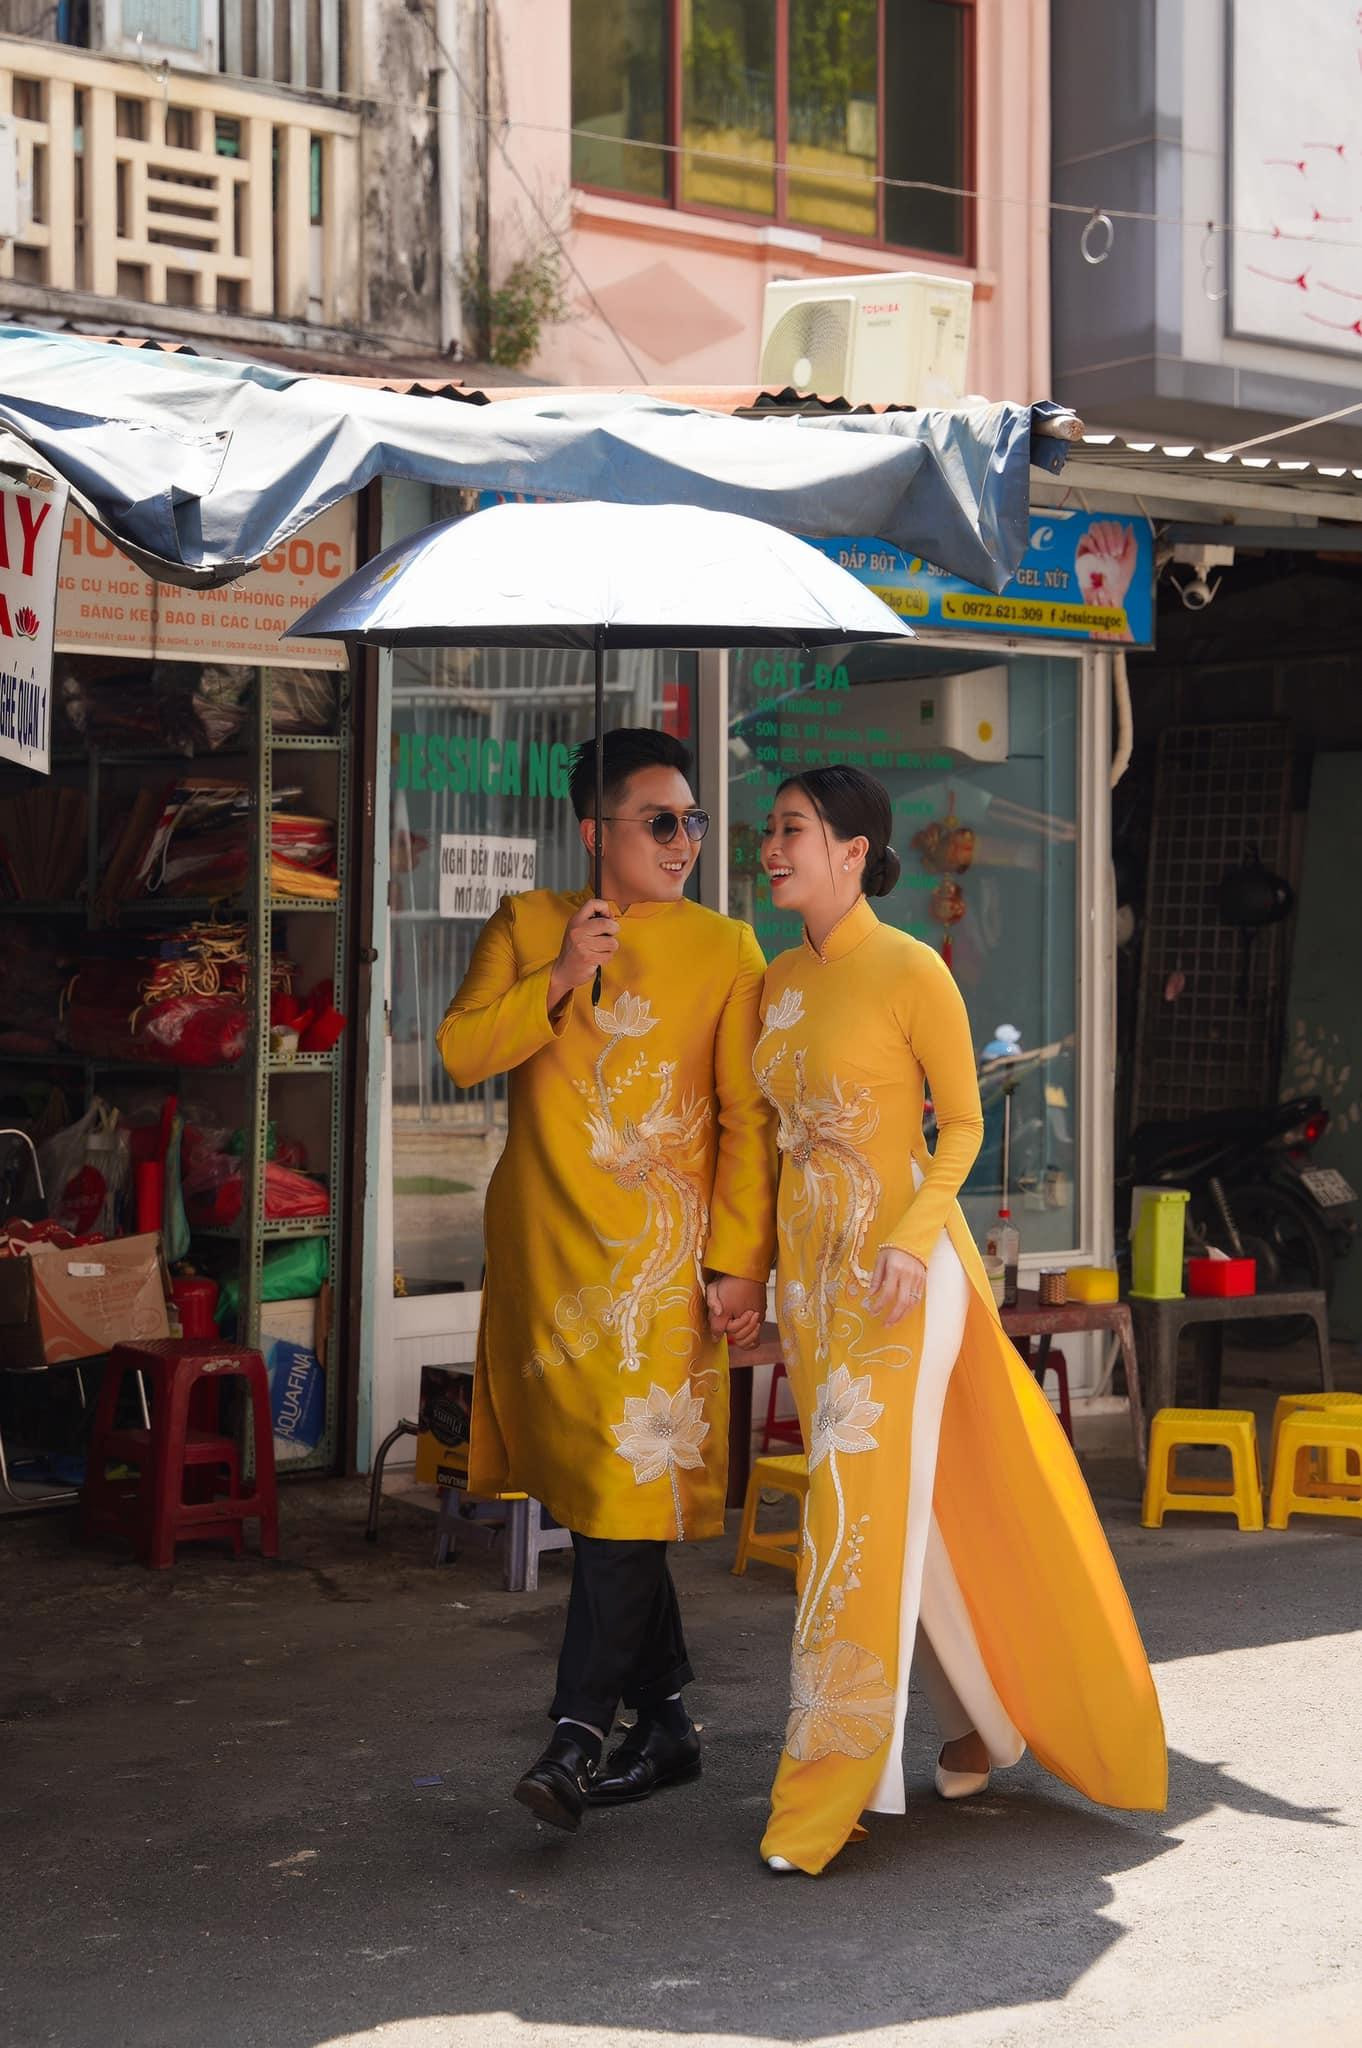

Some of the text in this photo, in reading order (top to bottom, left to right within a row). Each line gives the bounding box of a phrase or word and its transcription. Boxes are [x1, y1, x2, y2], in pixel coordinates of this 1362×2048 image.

[0, 491, 52, 576] Y
[1016, 568, 1040, 587] GEL
[396, 735, 522, 797] JESSICA
[521, 853, 535, 880] 28
[274, 1353, 315, 1440] AQUAFINA
